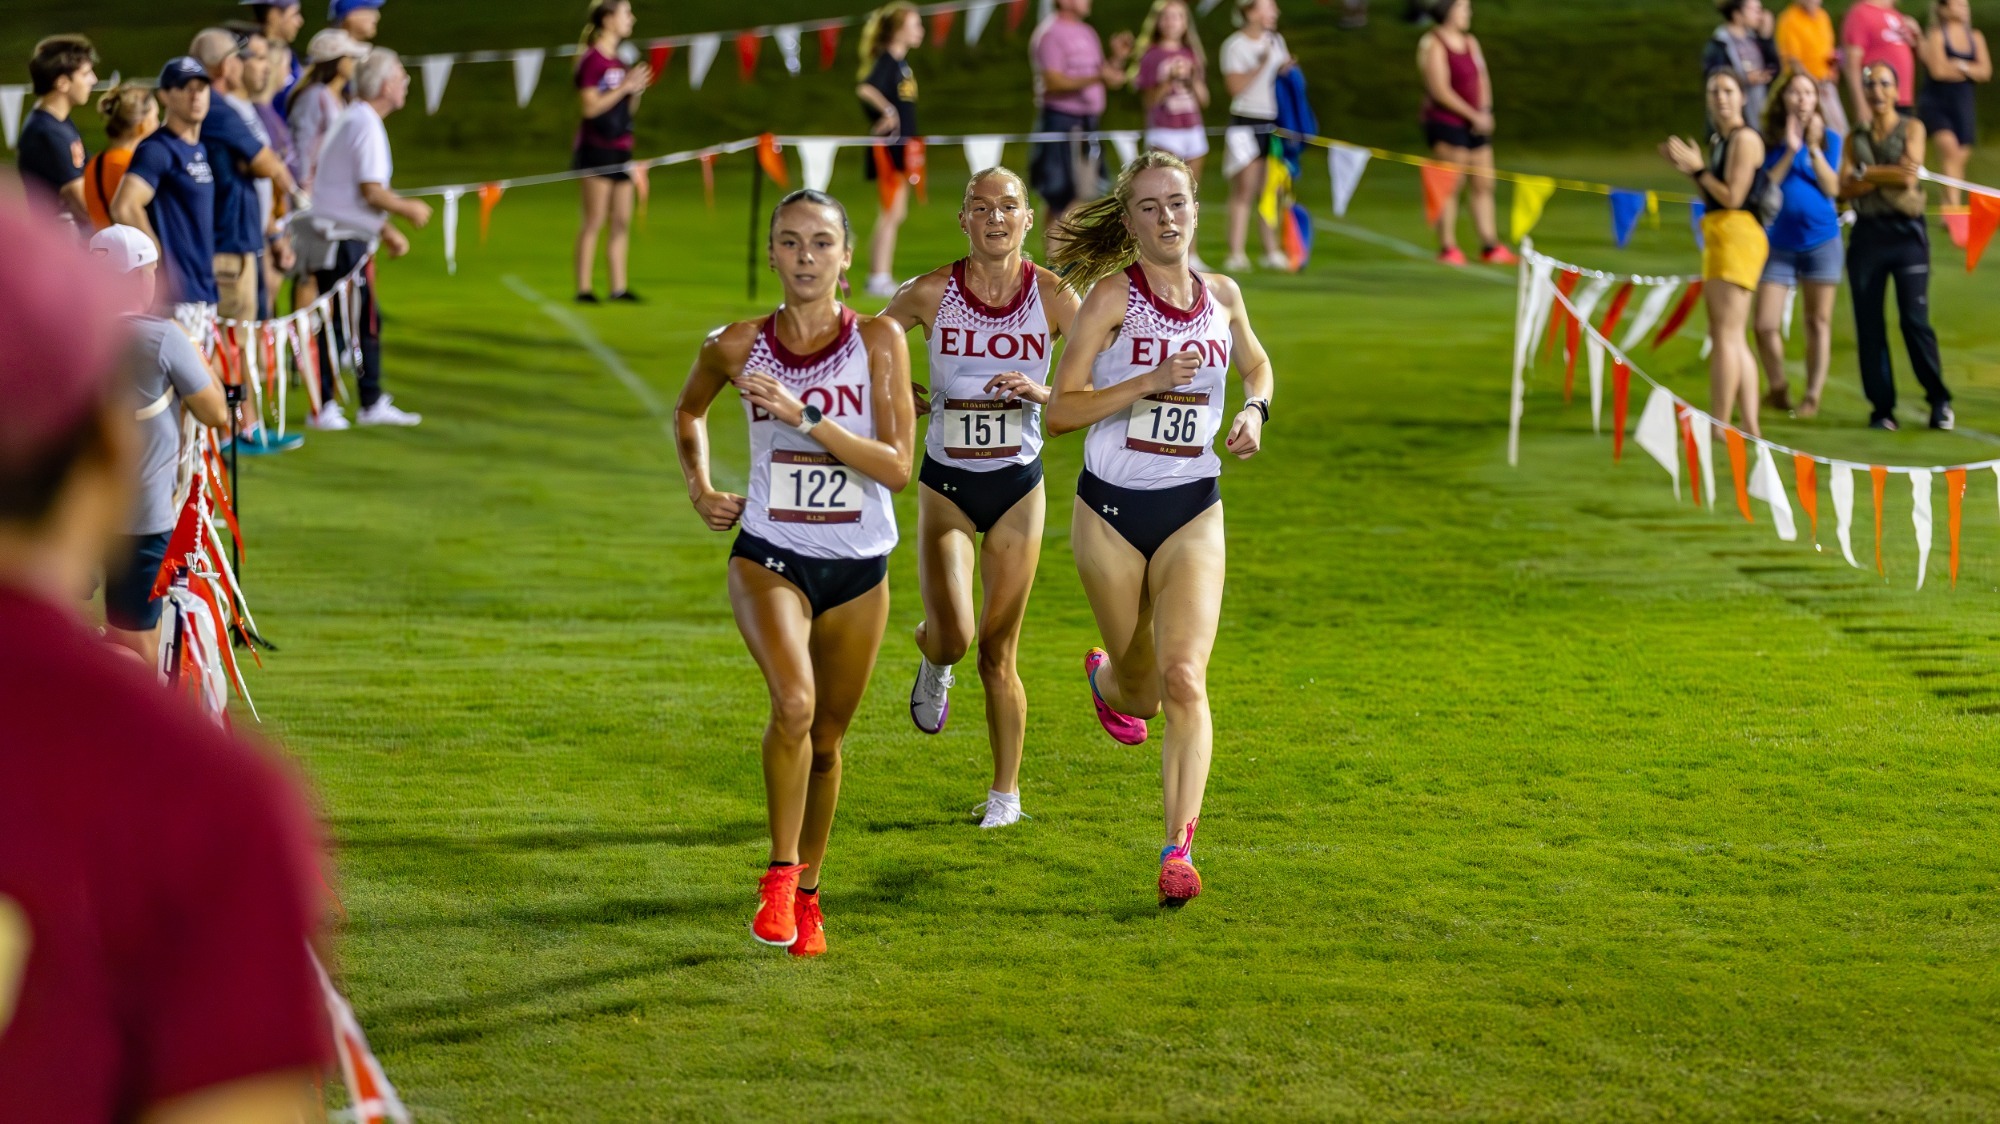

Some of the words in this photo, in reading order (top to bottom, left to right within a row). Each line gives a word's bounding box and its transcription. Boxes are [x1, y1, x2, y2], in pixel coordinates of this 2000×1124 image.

[940, 327, 1046, 360] ELON
[960, 413, 1006, 446] 151
[1150, 406, 1198, 443] 136
[790, 469, 847, 507] 122
